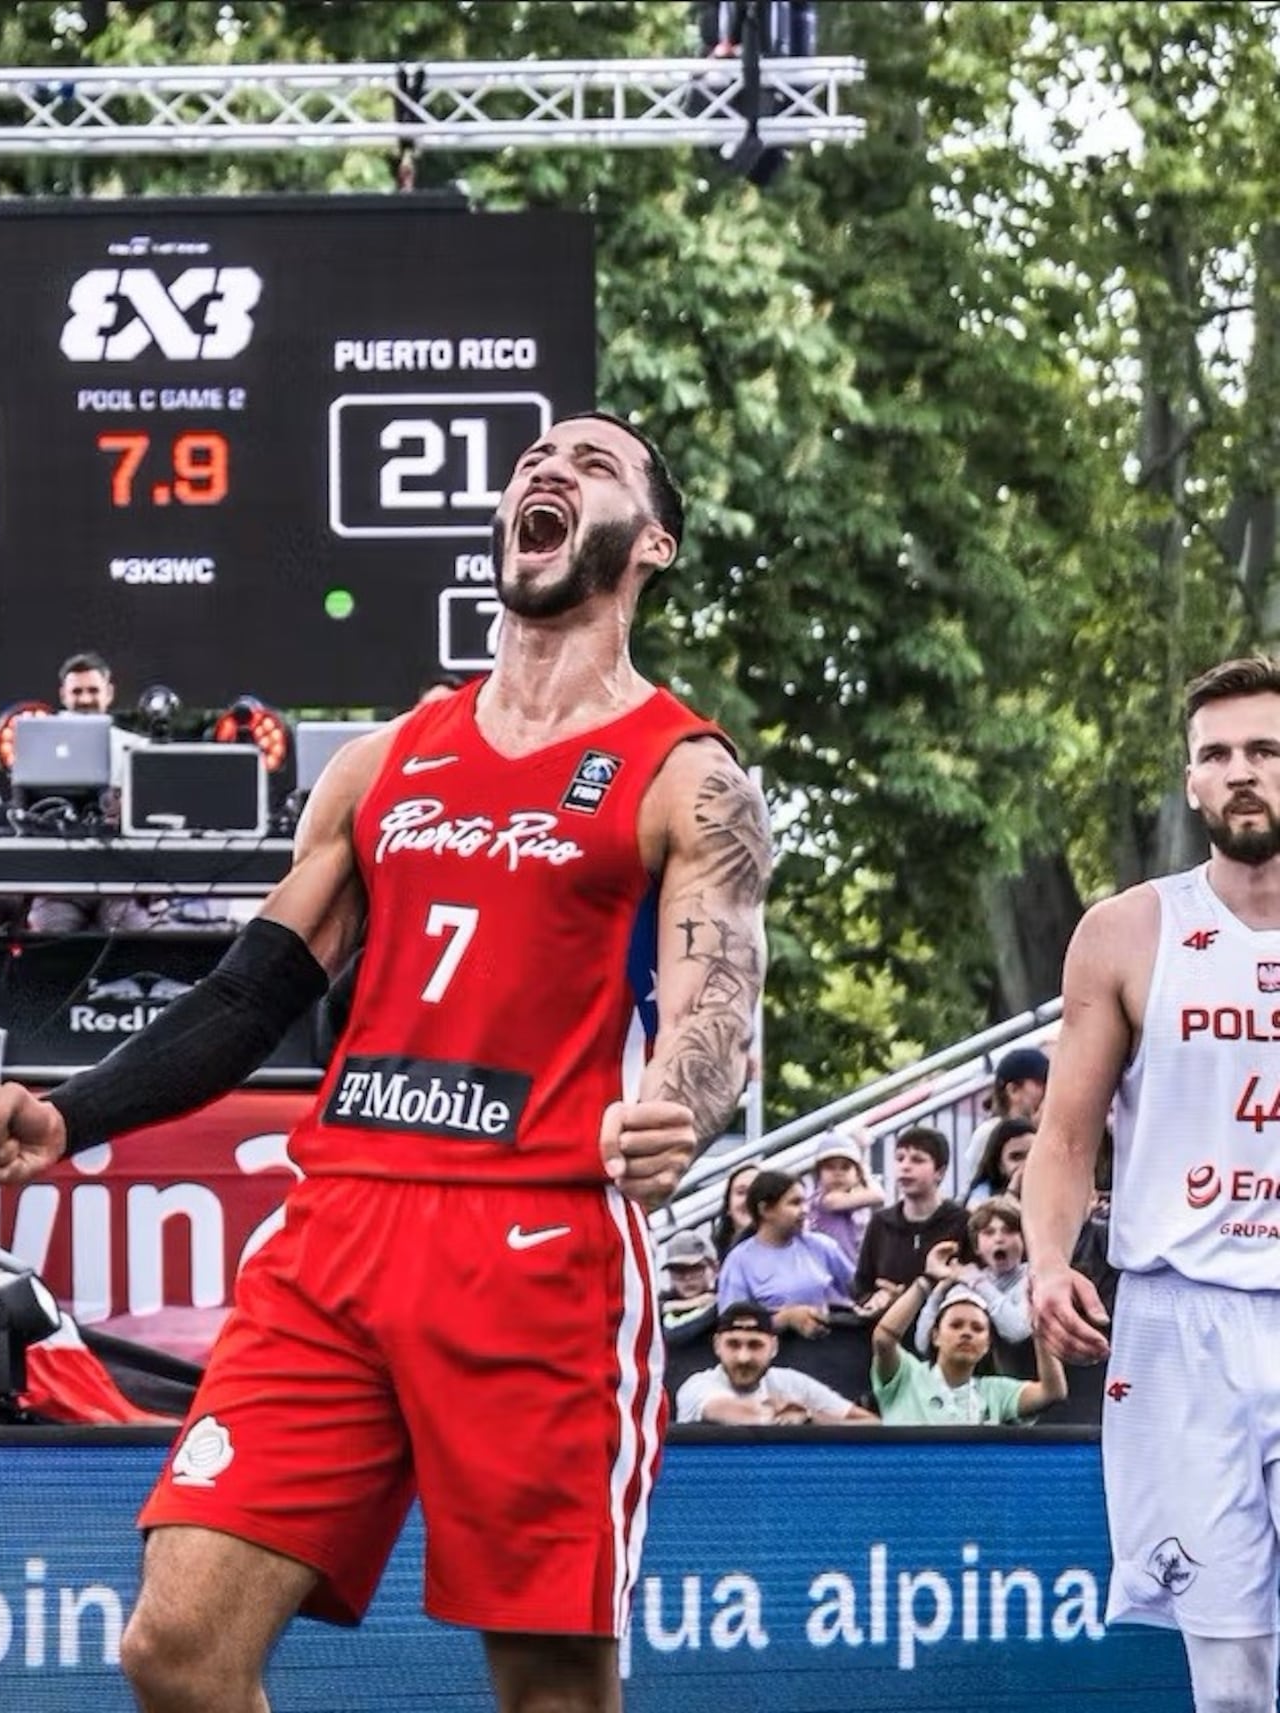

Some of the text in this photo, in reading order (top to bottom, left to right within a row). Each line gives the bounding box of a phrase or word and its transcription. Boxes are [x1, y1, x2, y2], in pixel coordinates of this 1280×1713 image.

[334, 338, 537, 371] PUERTO RICO
[77, 387, 246, 411] POOL C GAME 2
[96, 431, 228, 507] 7.9
[380, 417, 503, 509] 21
[375, 797, 584, 872] Puerto Rico
[420, 903, 480, 1003] 7
[1182, 929, 1220, 951] 4F
[1220, 1222, 1280, 1240] GRUPA
[806, 1542, 1106, 1671] alpina
